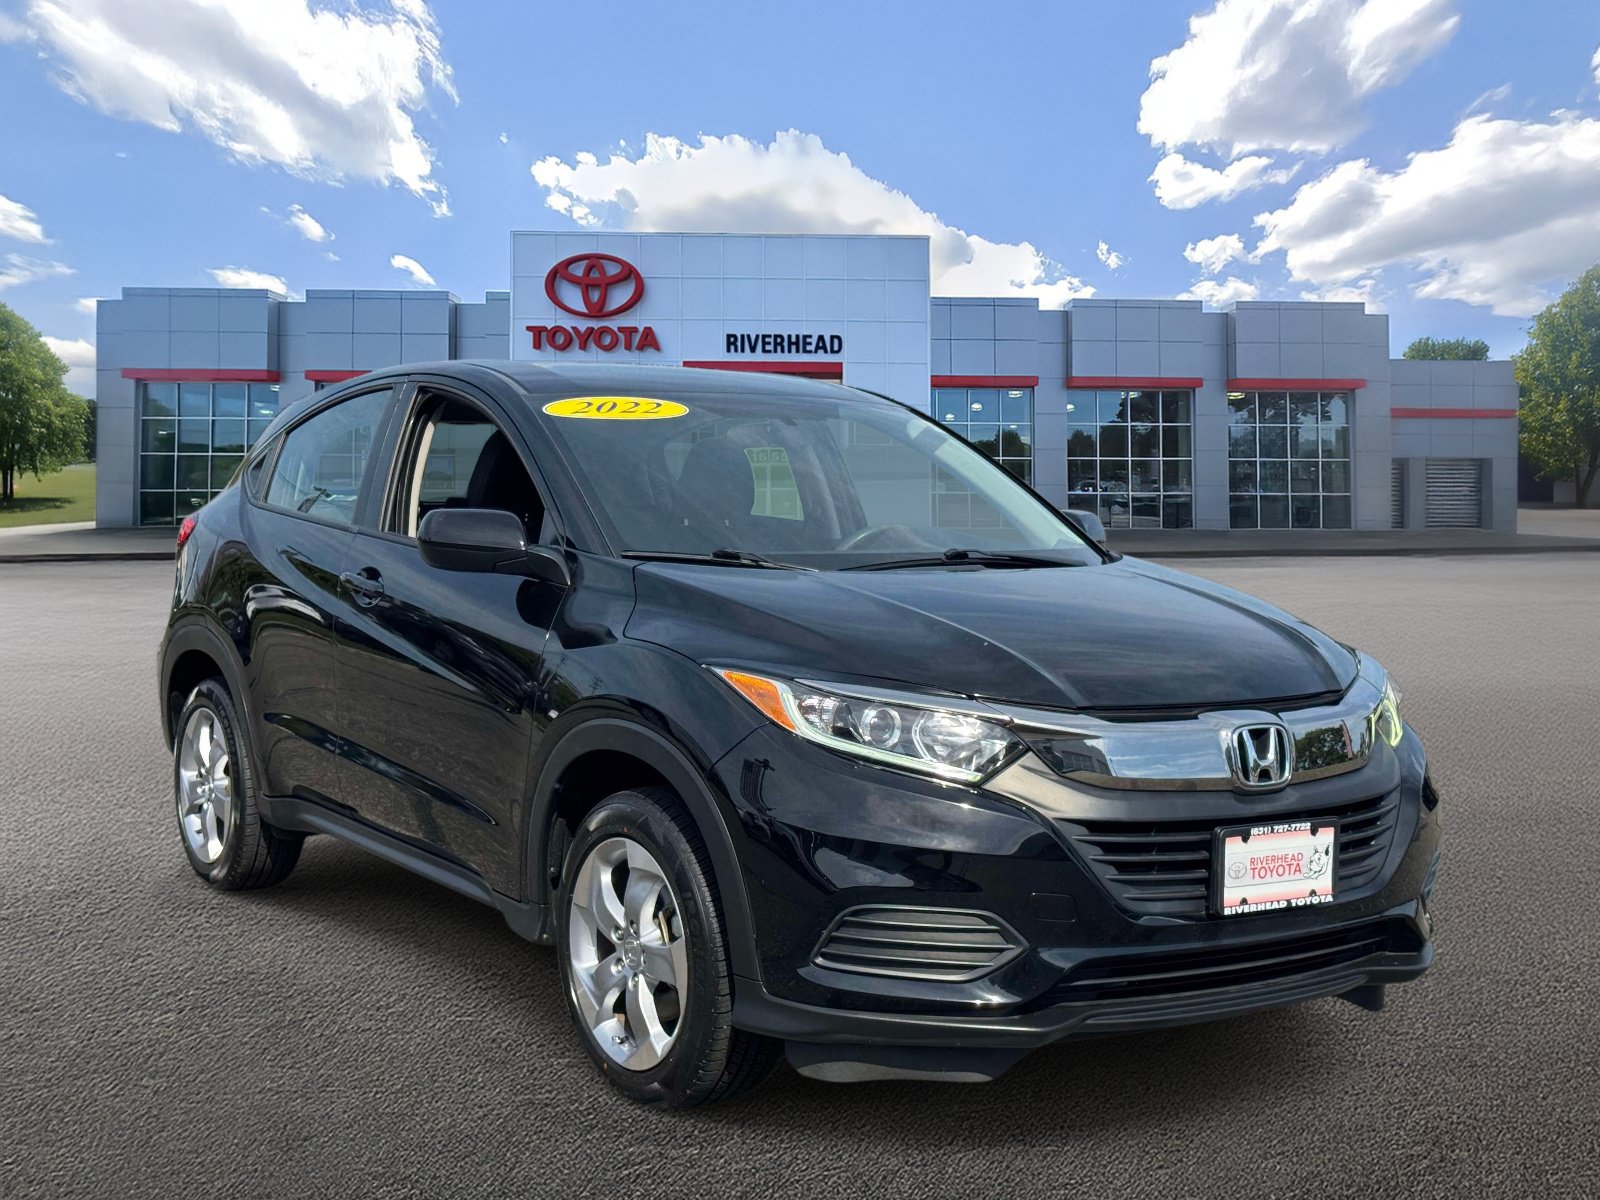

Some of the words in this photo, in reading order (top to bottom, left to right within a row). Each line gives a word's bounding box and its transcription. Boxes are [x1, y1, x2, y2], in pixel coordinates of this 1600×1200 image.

[525, 325, 661, 352] TOYOTA
[725, 333, 843, 354] RIVERHEAD
[570, 401, 663, 415] 2022
[1240, 726, 1282, 785] H
[1250, 826, 1272, 836] (631)
[1273, 822, 1312, 833] 727-7722
[1249, 852, 1304, 867] RIVERHEAD
[1249, 863, 1303, 880] TOYOTA
[1224, 900, 1288, 916] RIVERHEAD
[1290, 894, 1334, 907] TOYOTA
